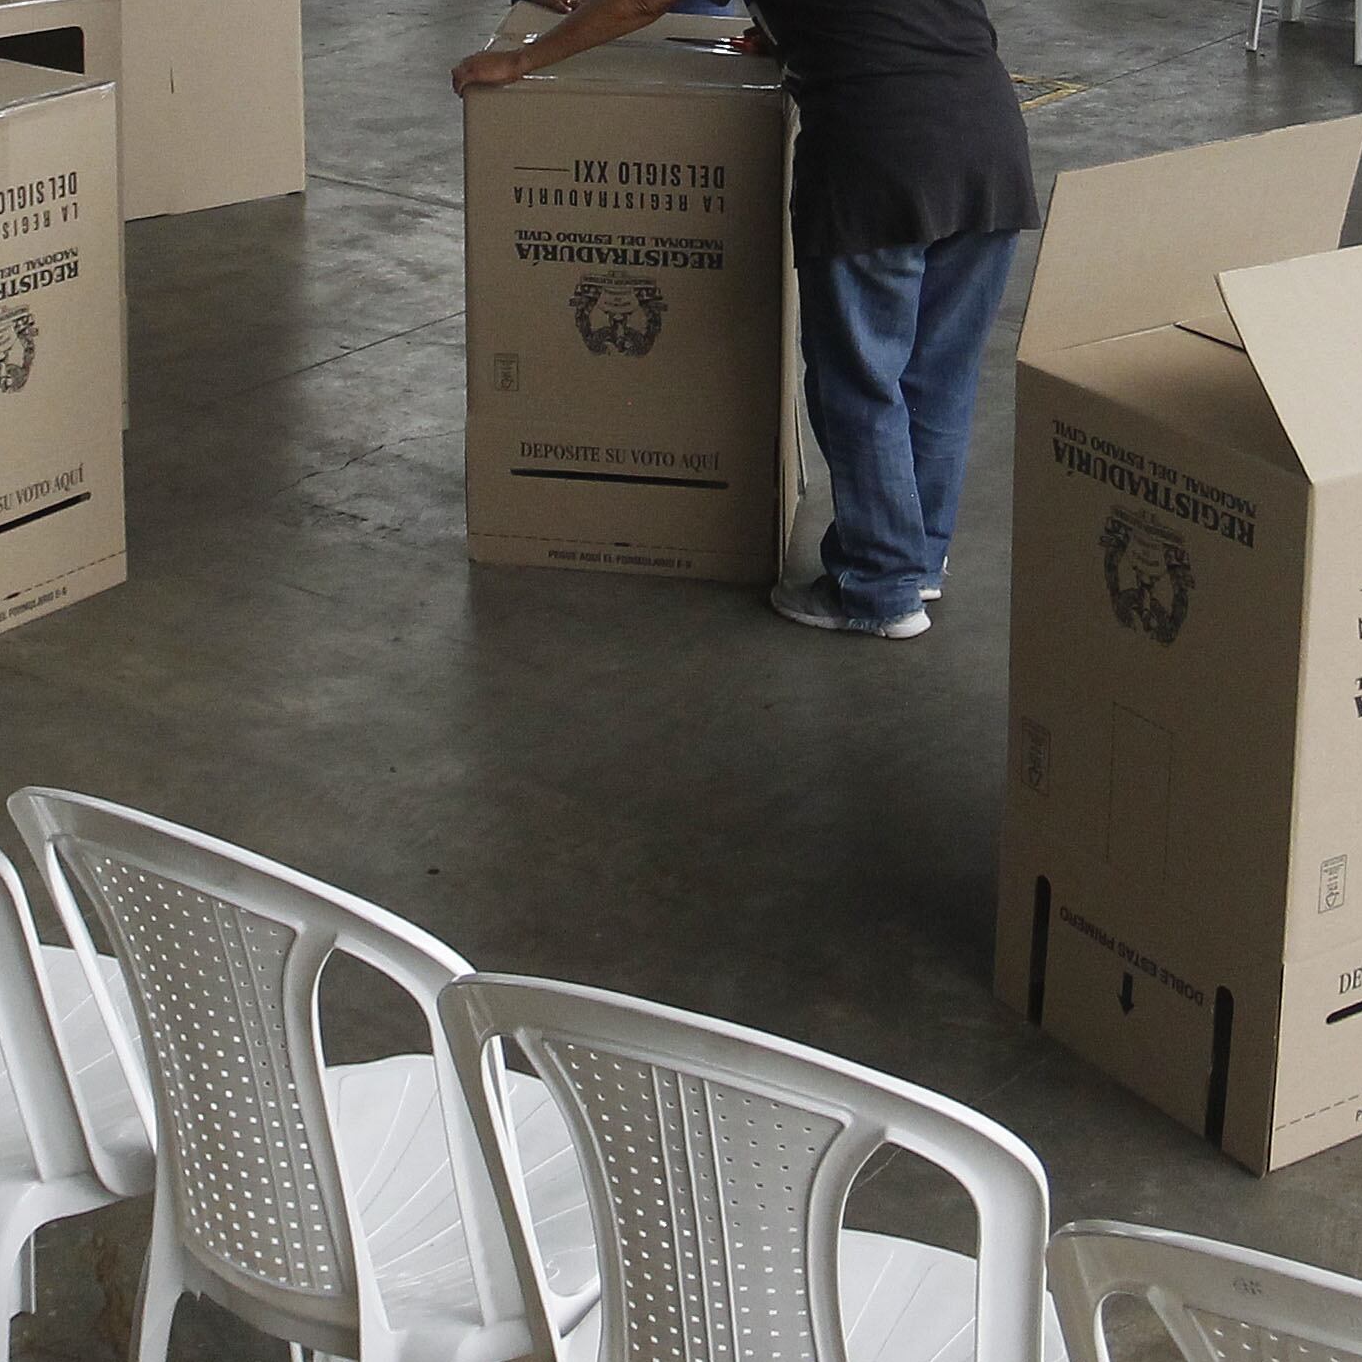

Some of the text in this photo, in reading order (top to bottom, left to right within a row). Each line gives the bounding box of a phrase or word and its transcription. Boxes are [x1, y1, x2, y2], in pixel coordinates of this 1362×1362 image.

[573, 159, 609, 184] XXI
[61, 202, 78, 223] LA
[513, 186, 725, 214] LA REGISTRADURÍA
[556, 231, 613, 246] ESTADO
[620, 234, 647, 247] DEL
[23, 246, 79, 274] NACIONAL
[514, 242, 724, 270] REGISTRADURÍA
[520, 441, 720, 473] DEPOSITE SU VOTO AQUÍ
[1091, 436, 1145, 471] ESTADO
[15, 480, 50, 506] VOTO
[53, 462, 85, 494] AQUÍ
[1149, 460, 1178, 485] DEL
[1052, 438, 1256, 549] REGISTRADURÍA
